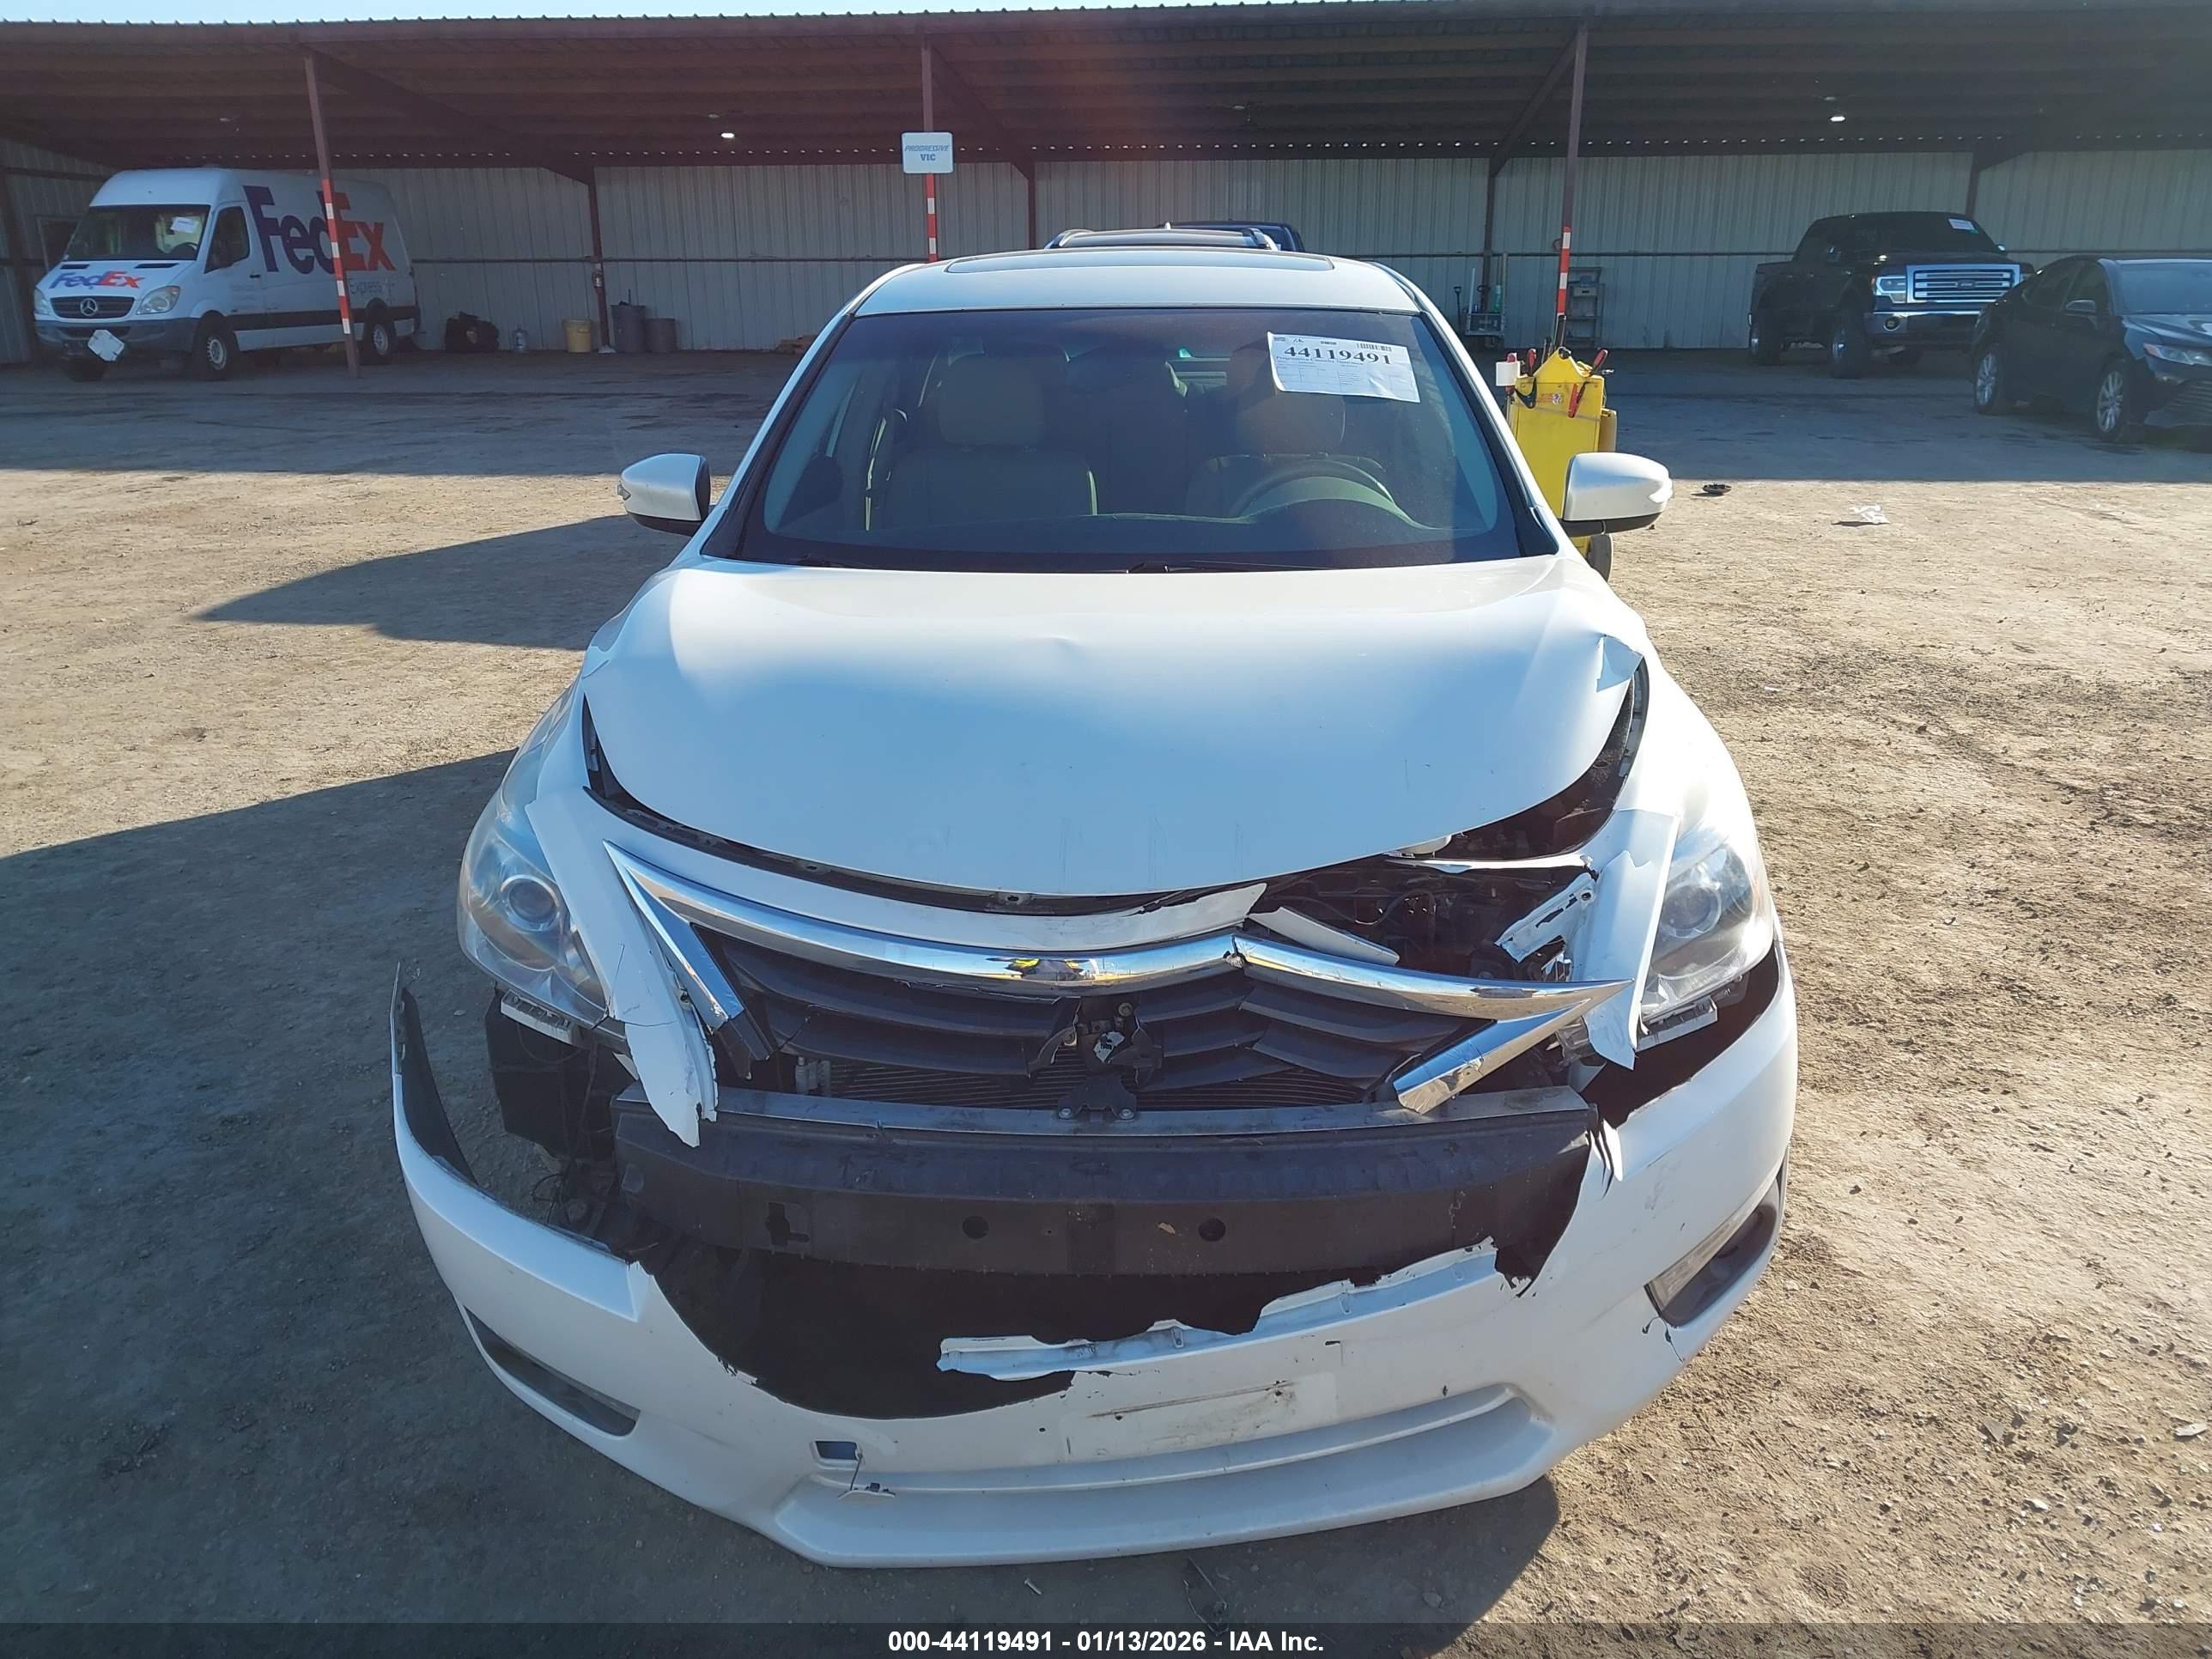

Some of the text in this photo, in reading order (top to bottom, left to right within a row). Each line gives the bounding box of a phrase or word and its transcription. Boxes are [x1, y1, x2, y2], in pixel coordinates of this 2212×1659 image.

[242, 185, 397, 275] FedEx
[48, 270, 146, 289] FedEx
[1284, 346, 1391, 365] 44119491
